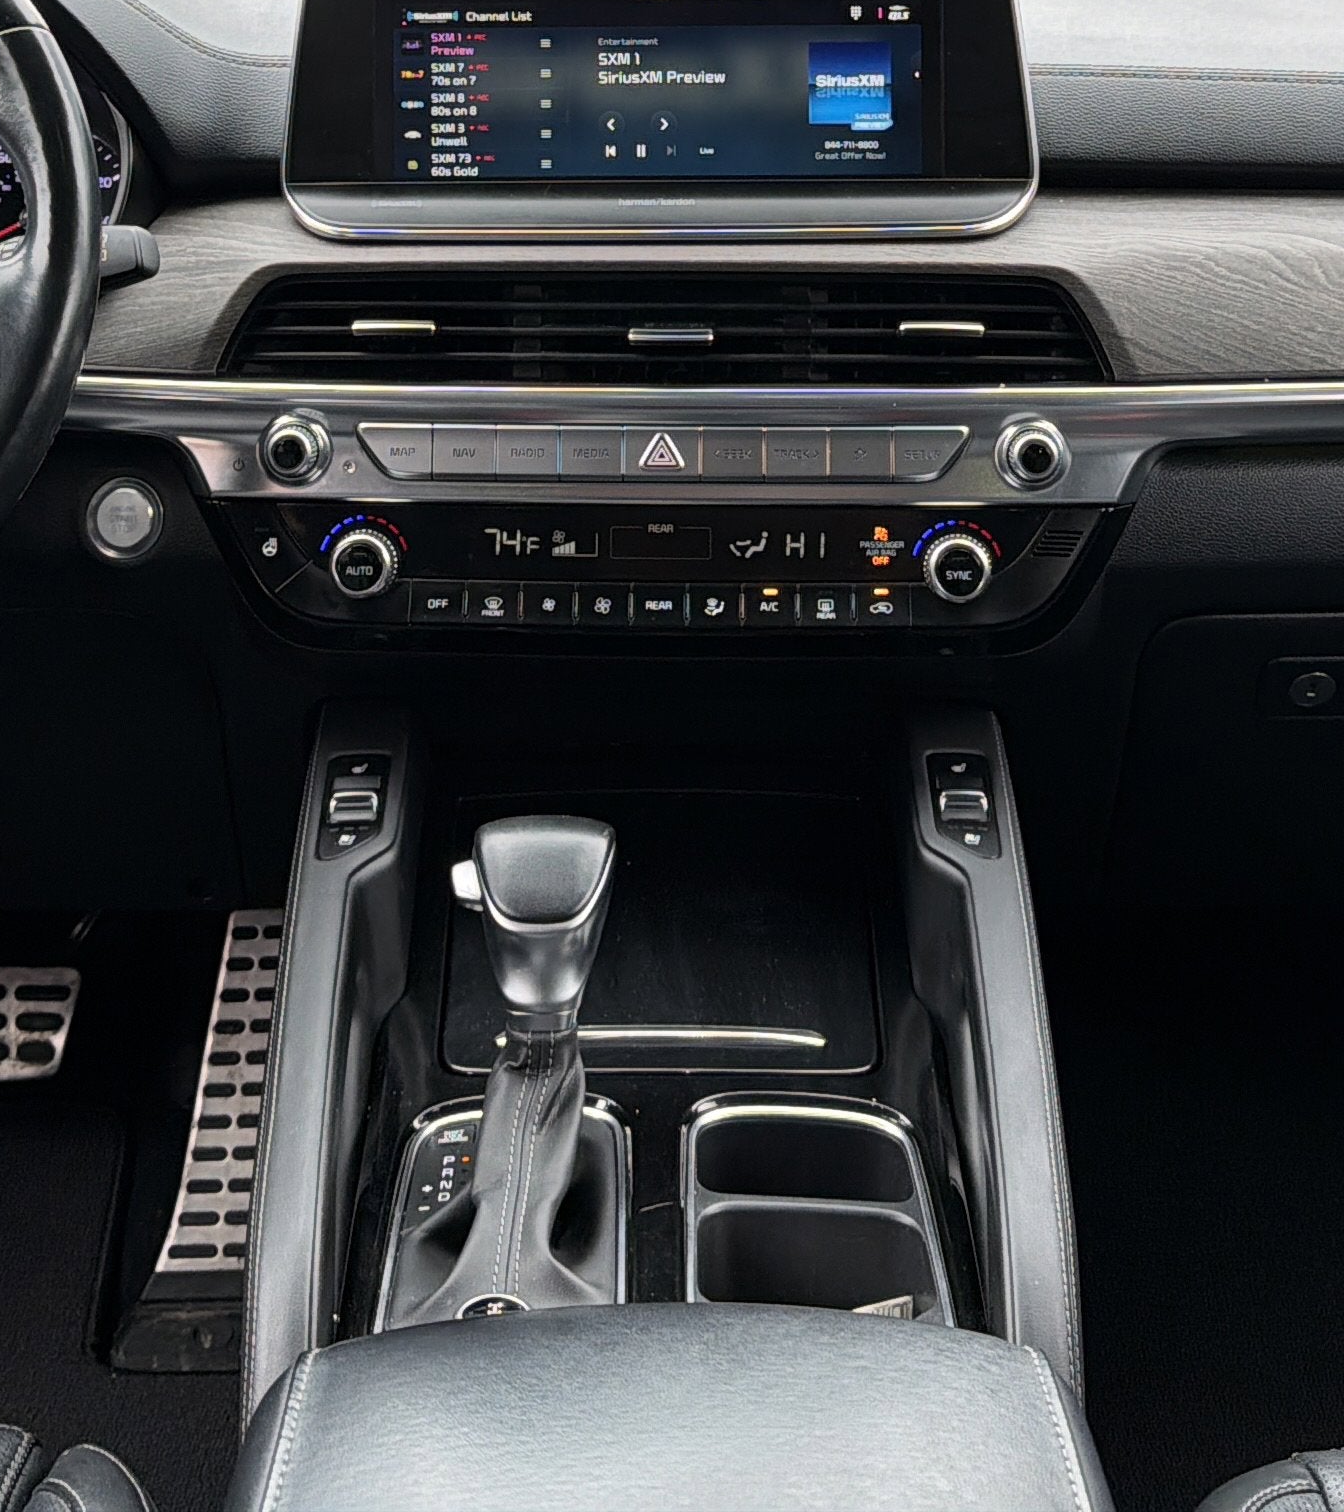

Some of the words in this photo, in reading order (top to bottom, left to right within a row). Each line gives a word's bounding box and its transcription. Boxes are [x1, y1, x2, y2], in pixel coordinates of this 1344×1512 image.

[466, 11, 510, 22] Channel
[511, 11, 533, 22] List
[431, 33, 455, 42] SXM
[457, 33, 462, 42] 1
[598, 37, 659, 47] Entertainment
[431, 46, 475, 56] Preview
[598, 53, 630, 66] SXM
[633, 53, 641, 66] 1
[431, 63, 455, 73] SXM
[457, 63, 464, 73] 7
[431, 76, 451, 86] 70s
[453, 78, 467, 86] on
[469, 76, 477, 86] 7
[598, 70, 663, 84] SiriusXM
[666, 70, 726, 84] Preview
[815, 74, 885, 87] SiriusXM
[431, 93, 455, 103] SXM
[457, 93, 465, 103] 8
[431, 106, 451, 117] 80s
[453, 108, 467, 117] on
[469, 106, 477, 117] 8
[431, 123, 455, 134] SXM
[457, 123, 465, 134] 3
[431, 136, 467, 147] Unwell
[431, 154, 455, 164] SXM
[458, 154, 472, 164] 73
[815, 152, 840, 161] Great
[841, 152, 864, 161] Offer
[431, 167, 451, 177] 60s
[454, 167, 479, 177] Gold
[389, 446, 416, 457] MAP
[452, 447, 476, 458] NAV
[510, 447, 545, 459] RADIO
[572, 447, 609, 459] MEDIA
[647, 524, 674, 534] REAR
[859, 541, 905, 550] PASSENGER
[872, 556, 890, 566] OFF
[345, 565, 373, 576] AUTO
[946, 570, 973, 581] SYNC
[427, 599, 449, 609] OFF
[645, 600, 673, 611] REAR
[759, 601, 779, 613] A/C
[481, 609, 504, 618] FRONT
[443, 1155, 456, 1166] P
[439, 1180, 453, 1190] N
[437, 1192, 451, 1202] D
